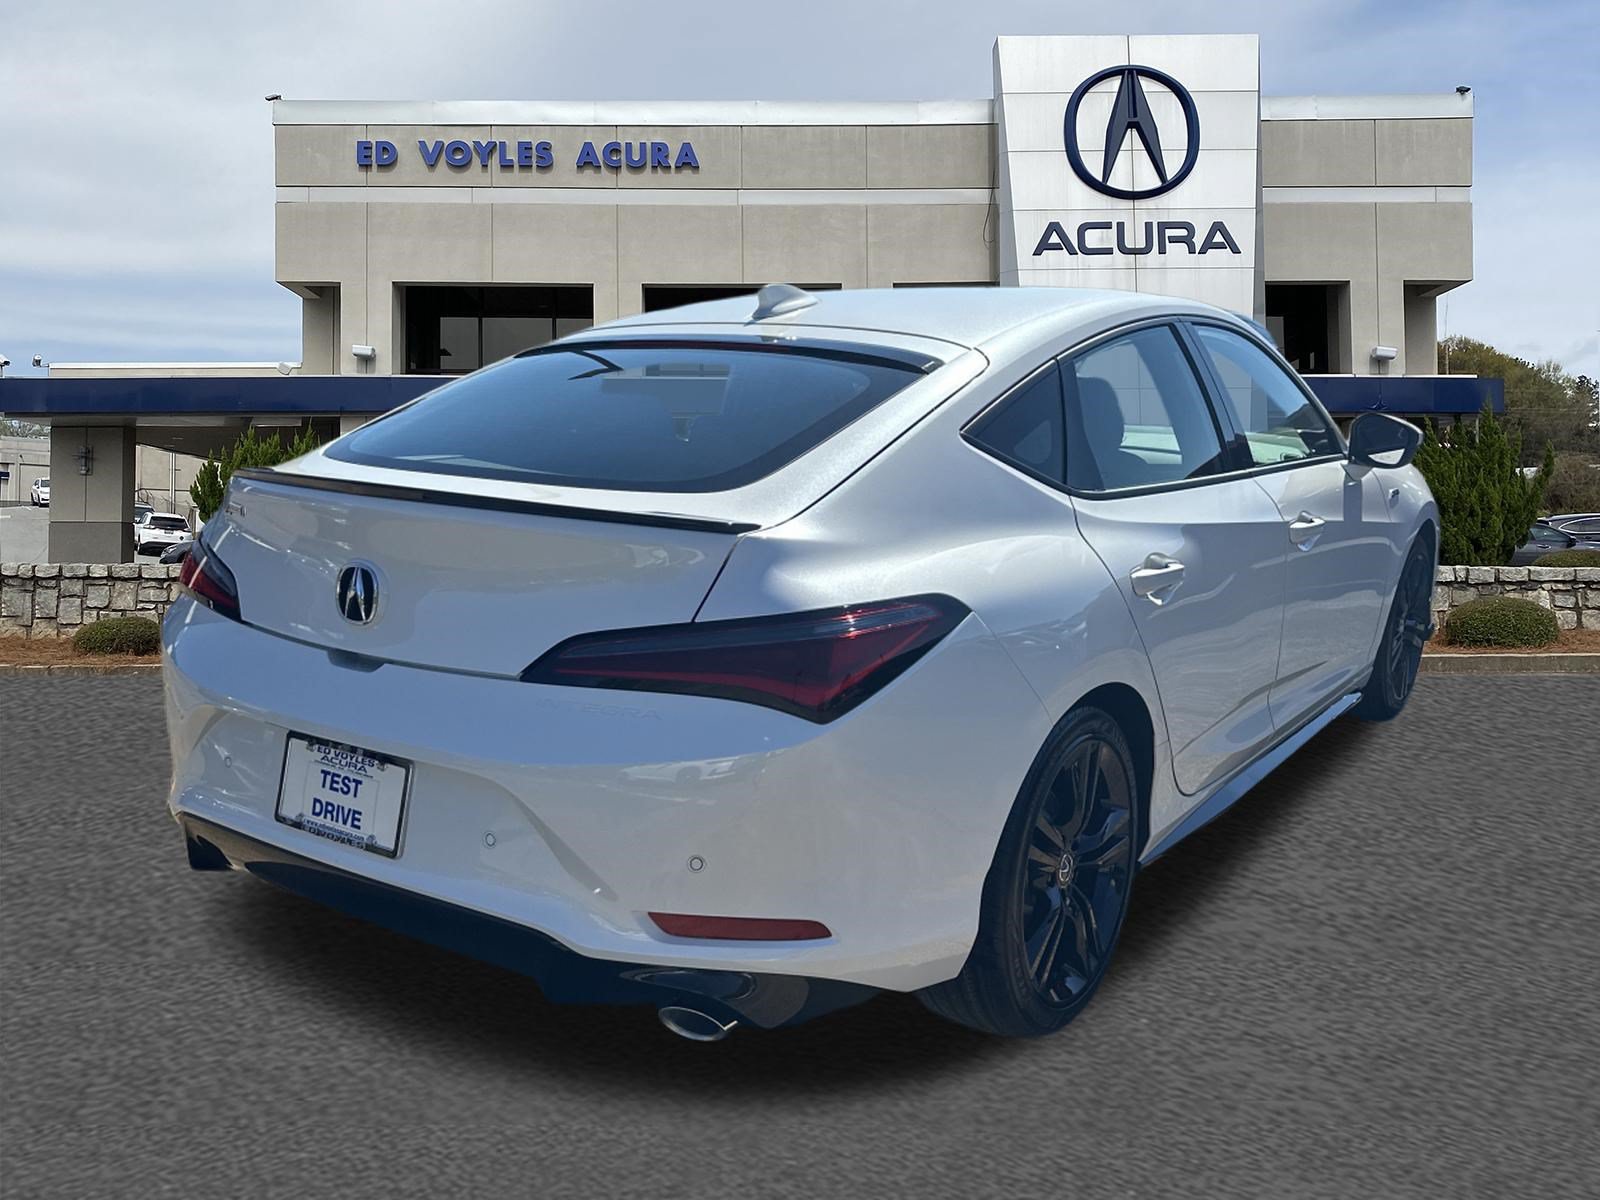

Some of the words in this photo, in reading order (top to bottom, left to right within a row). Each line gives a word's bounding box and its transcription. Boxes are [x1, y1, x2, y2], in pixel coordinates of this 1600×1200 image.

[356, 141, 398, 167] ED
[418, 141, 554, 167] VOYLES
[576, 141, 700, 168] ACURA
[1032, 221, 1242, 256] ACURA
[317, 745, 331, 755] ED
[334, 750, 375, 767] VOYLES
[321, 755, 368, 774] ACURA
[320, 769, 363, 798] TEST
[311, 797, 362, 830] DRIVE
